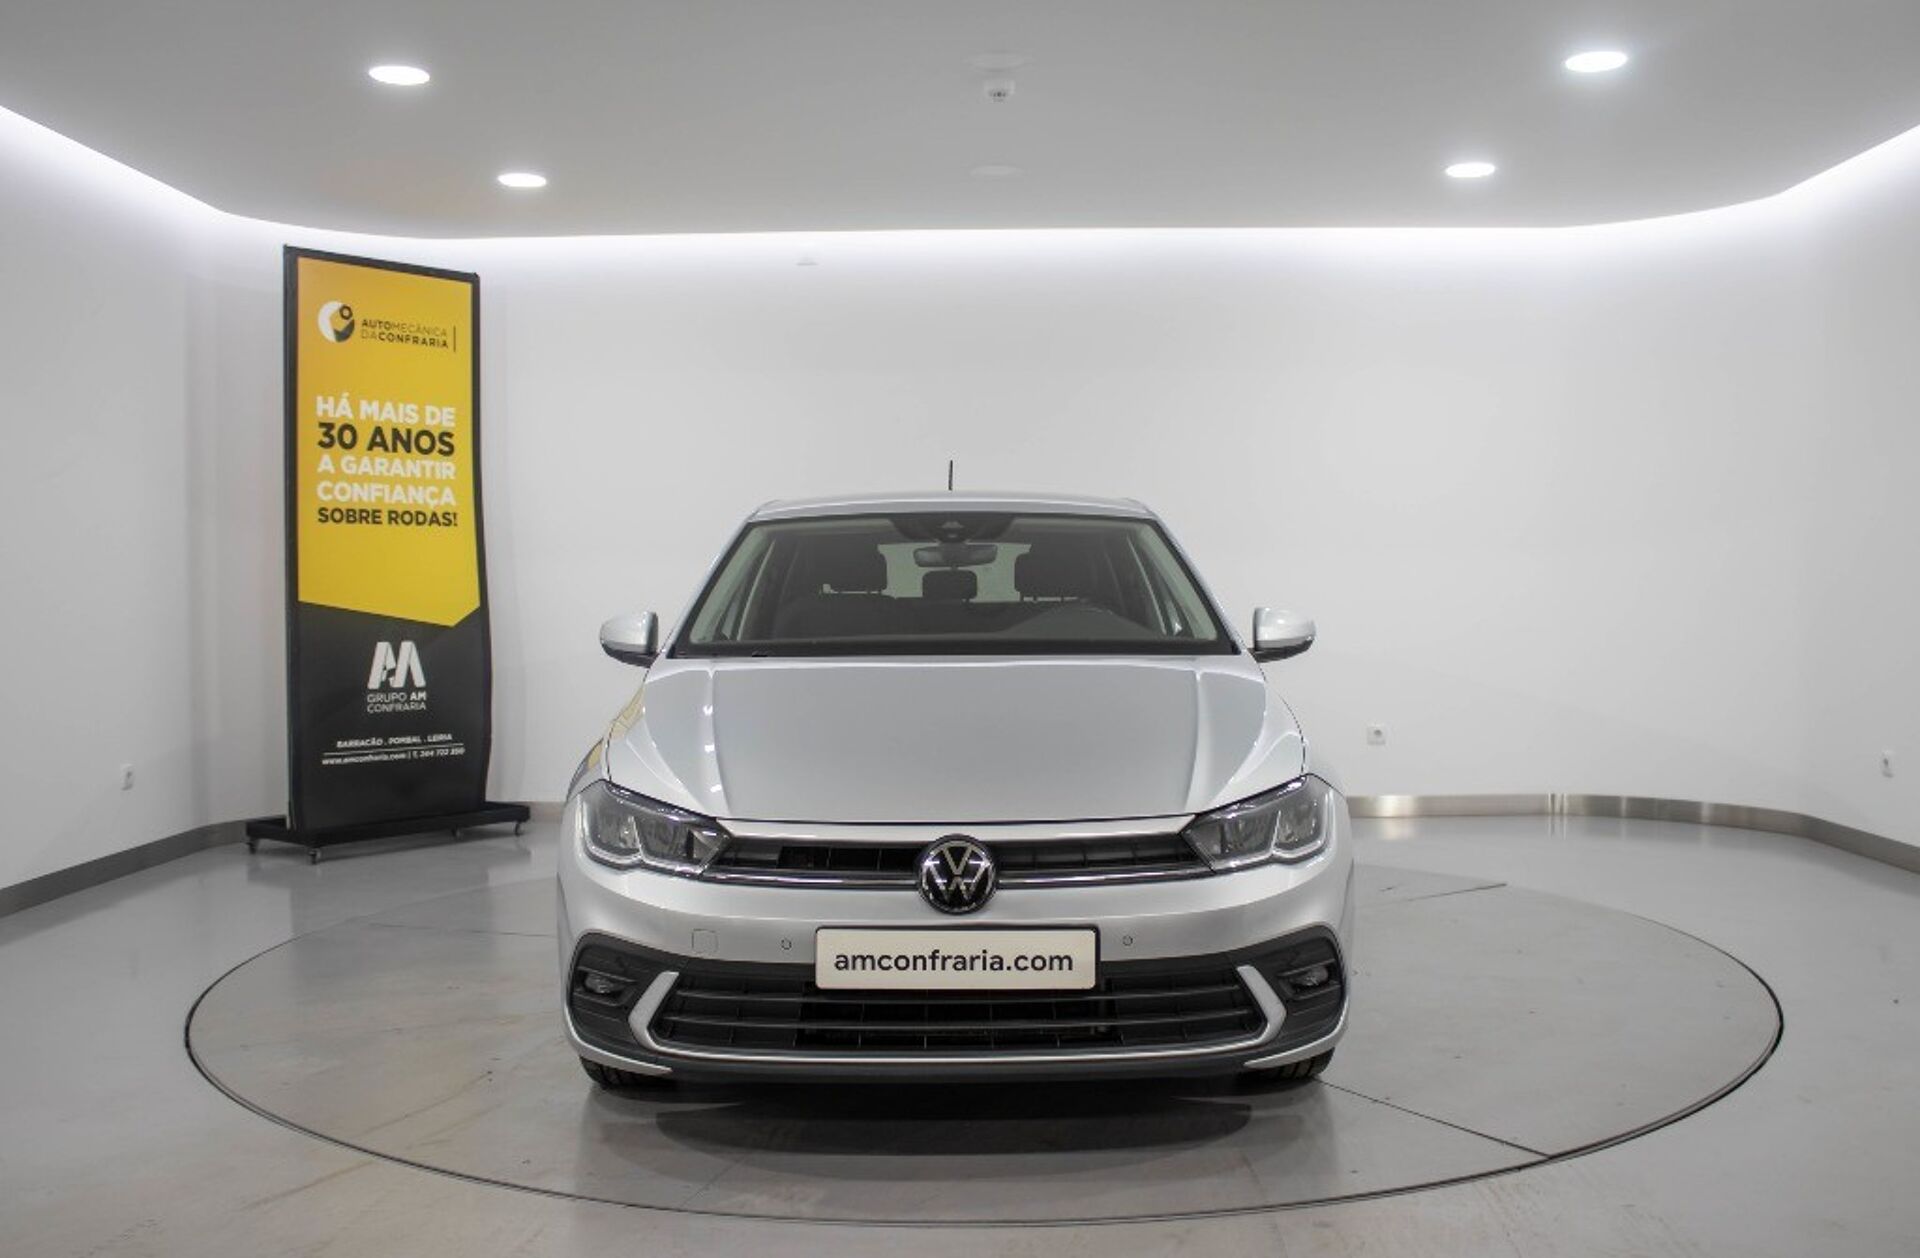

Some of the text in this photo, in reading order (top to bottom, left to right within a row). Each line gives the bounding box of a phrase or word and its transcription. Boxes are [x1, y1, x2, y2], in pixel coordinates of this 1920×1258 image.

[361, 319, 447, 337] AUTOMECÂNICA
[361, 330, 448, 348] DACONFRARIA
[316, 393, 456, 427] HÁ MAIS DE
[317, 422, 455, 456] 30 ANOS
[317, 454, 456, 479] A GARANTIR
[316, 480, 457, 508] CONFIANÇA
[318, 507, 458, 527] SOBRE RODAS!
[367, 691, 427, 703] GRUPO AM
[367, 702, 427, 713] CONFRARIA
[834, 949, 1073, 971] amconfraria.com
